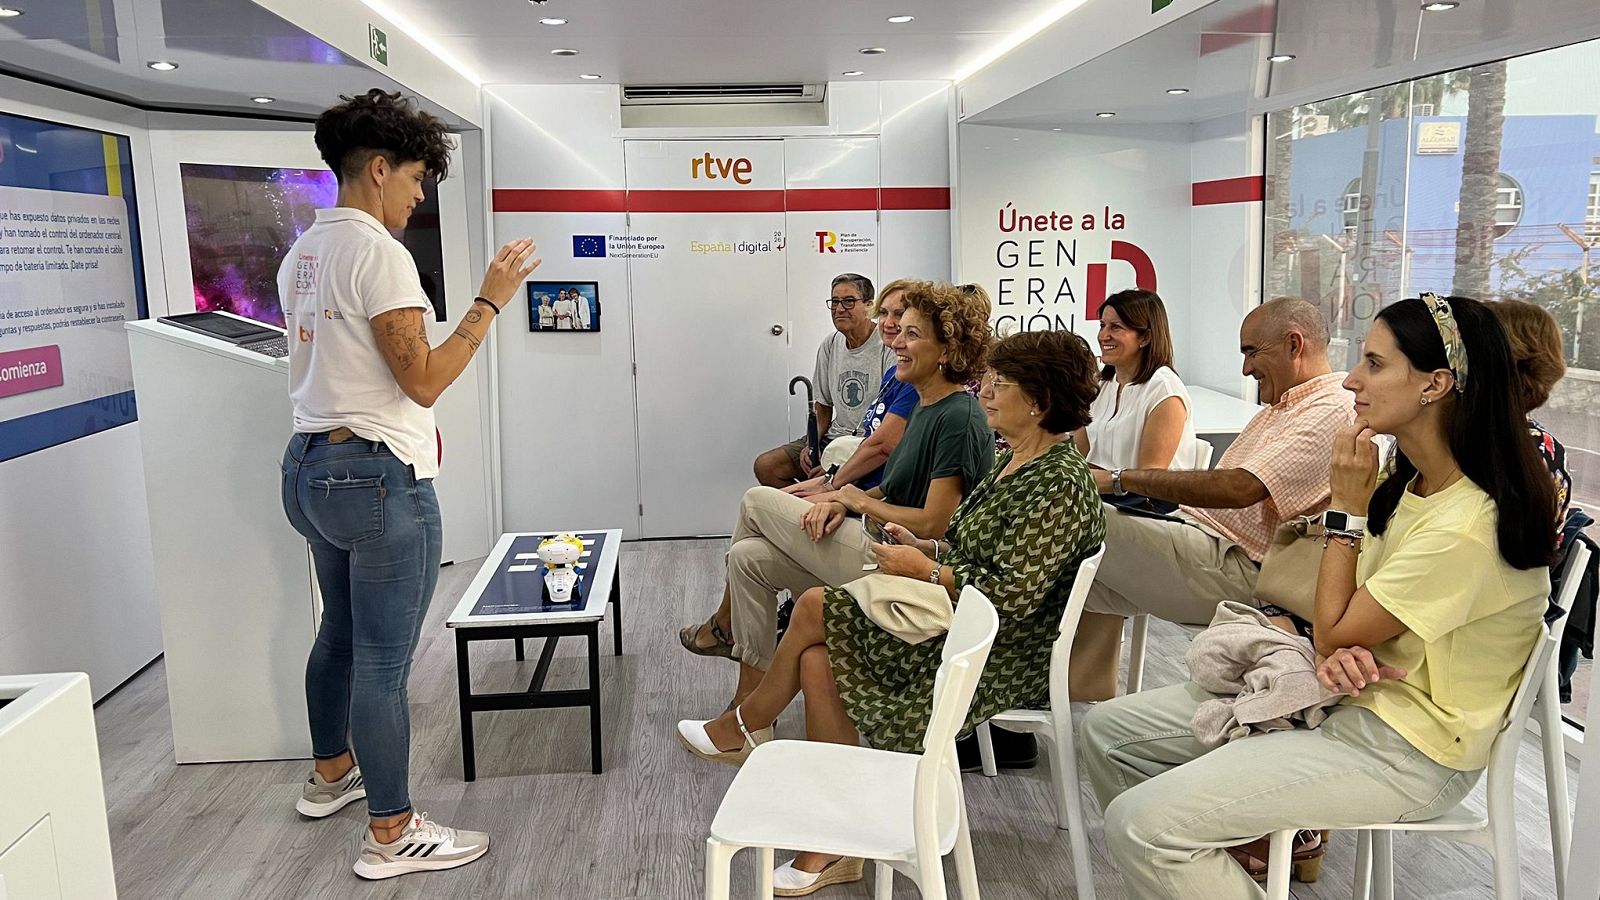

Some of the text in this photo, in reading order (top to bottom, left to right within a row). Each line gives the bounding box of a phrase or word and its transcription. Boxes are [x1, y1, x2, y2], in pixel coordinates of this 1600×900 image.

[691, 152, 753, 185] rtve
[9, 209, 21, 221] has
[22, 213, 49, 224] expuesto
[50, 211, 66, 223] datos
[67, 213, 90, 225] privados
[90, 216, 98, 224] en
[999, 202, 1126, 233] Únete a la
[3, 226, 17, 238] han
[17, 227, 41, 238] tomado
[41, 227, 48, 238] el
[48, 228, 69, 239] control
[69, 228, 78, 239] del
[78, 229, 104, 239] ordenador
[608, 234, 645, 242] Financiado
[10, 245, 35, 255] retomar
[36, 244, 43, 255] el
[65, 244, 73, 254] Te
[73, 244, 84, 254] han
[84, 244, 104, 254] cortado
[104, 244, 110, 254] el
[110, 244, 123, 254] cable
[637, 243, 665, 251] Europea
[690, 240, 772, 255] España digital
[996, 238, 1077, 269] GEN
[14, 260, 23, 272] de
[998, 276, 1076, 306] ERA
[6, 308, 14, 320] de
[14, 309, 34, 319] acceso
[34, 306, 40, 317] al
[40, 304, 66, 316] ordenador
[0, 360, 48, 382] omienza
